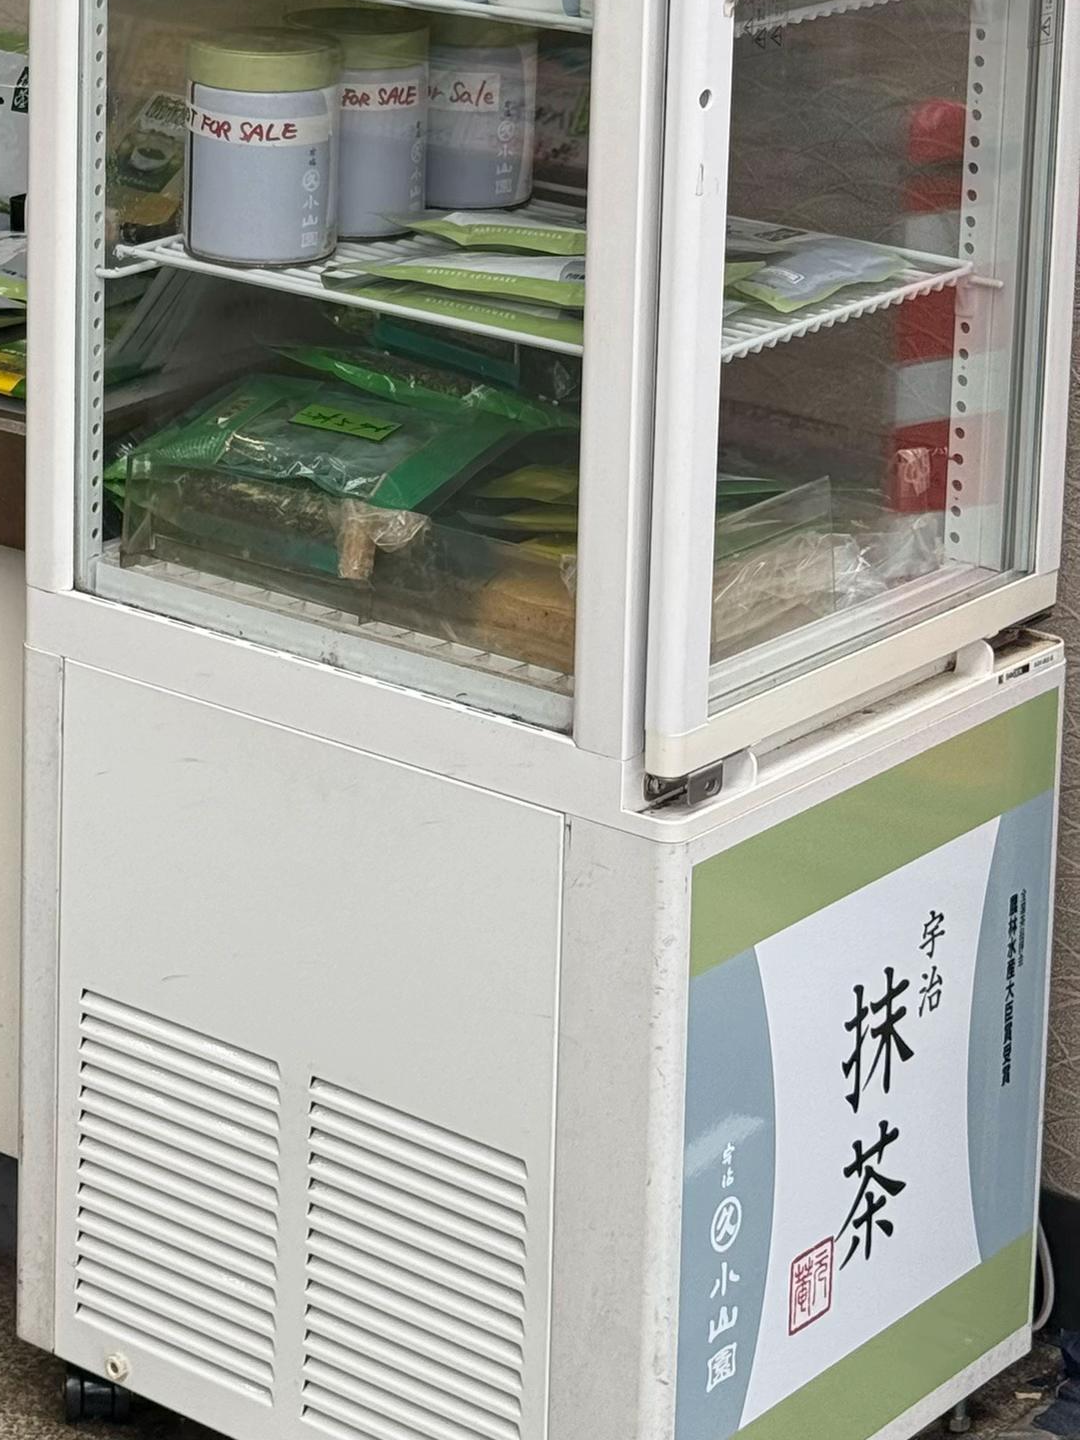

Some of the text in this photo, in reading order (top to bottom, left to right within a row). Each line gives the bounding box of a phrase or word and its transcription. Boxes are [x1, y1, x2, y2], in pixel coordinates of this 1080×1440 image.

[342, 83, 418, 107] FOR SALE
[449, 81, 496, 107] Sale
[200, 114, 298, 143] FOR SALE
[918, 910, 946, 1017] 宇治
[834, 967, 915, 1272] 抹茶
